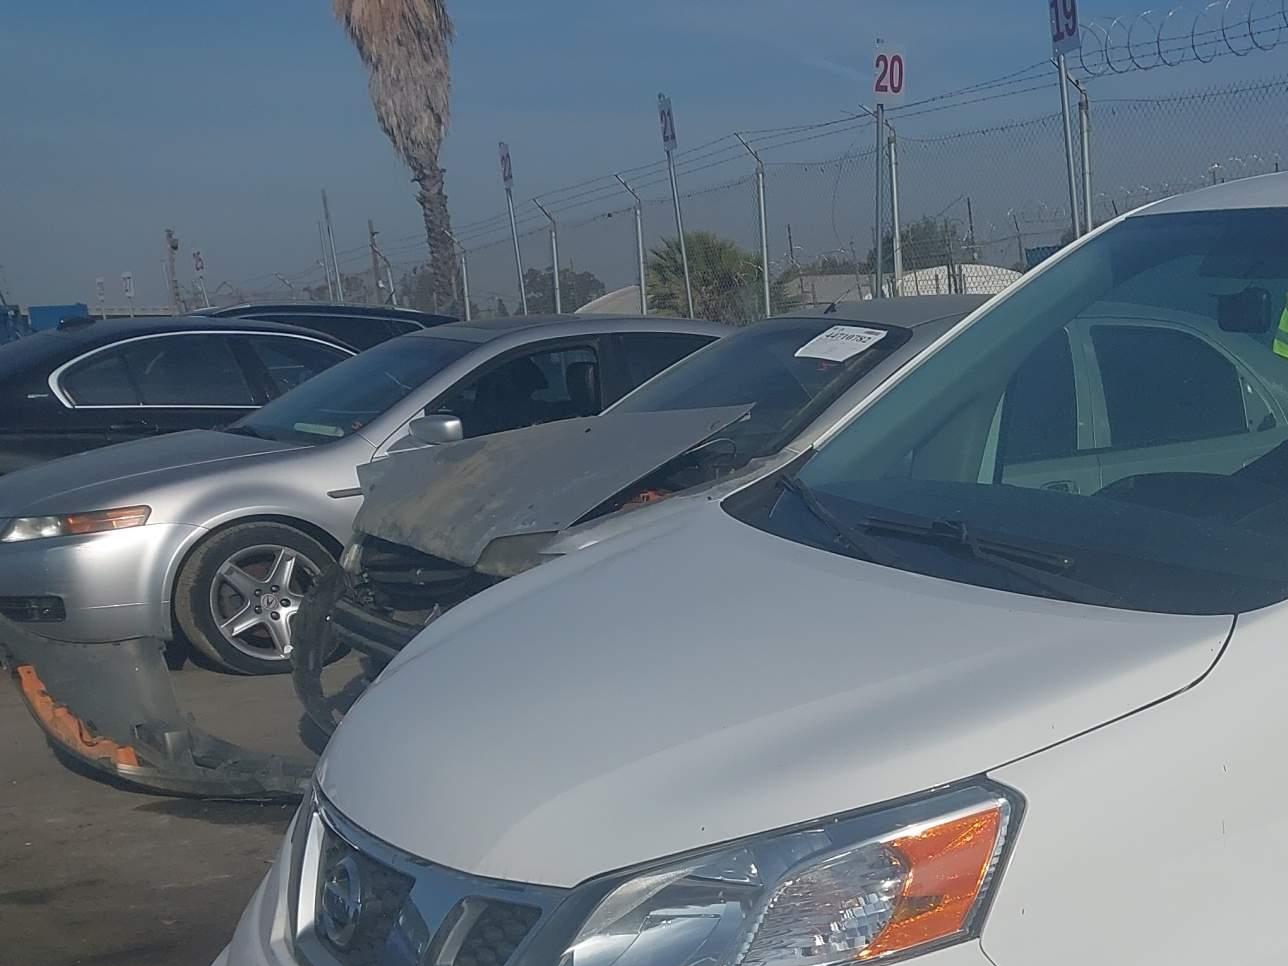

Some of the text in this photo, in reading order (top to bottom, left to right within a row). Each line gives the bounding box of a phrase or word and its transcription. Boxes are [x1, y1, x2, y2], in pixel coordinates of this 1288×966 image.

[1050, 0, 1076, 41] 19
[875, 54, 904, 93] 20
[660, 109, 676, 142] 21
